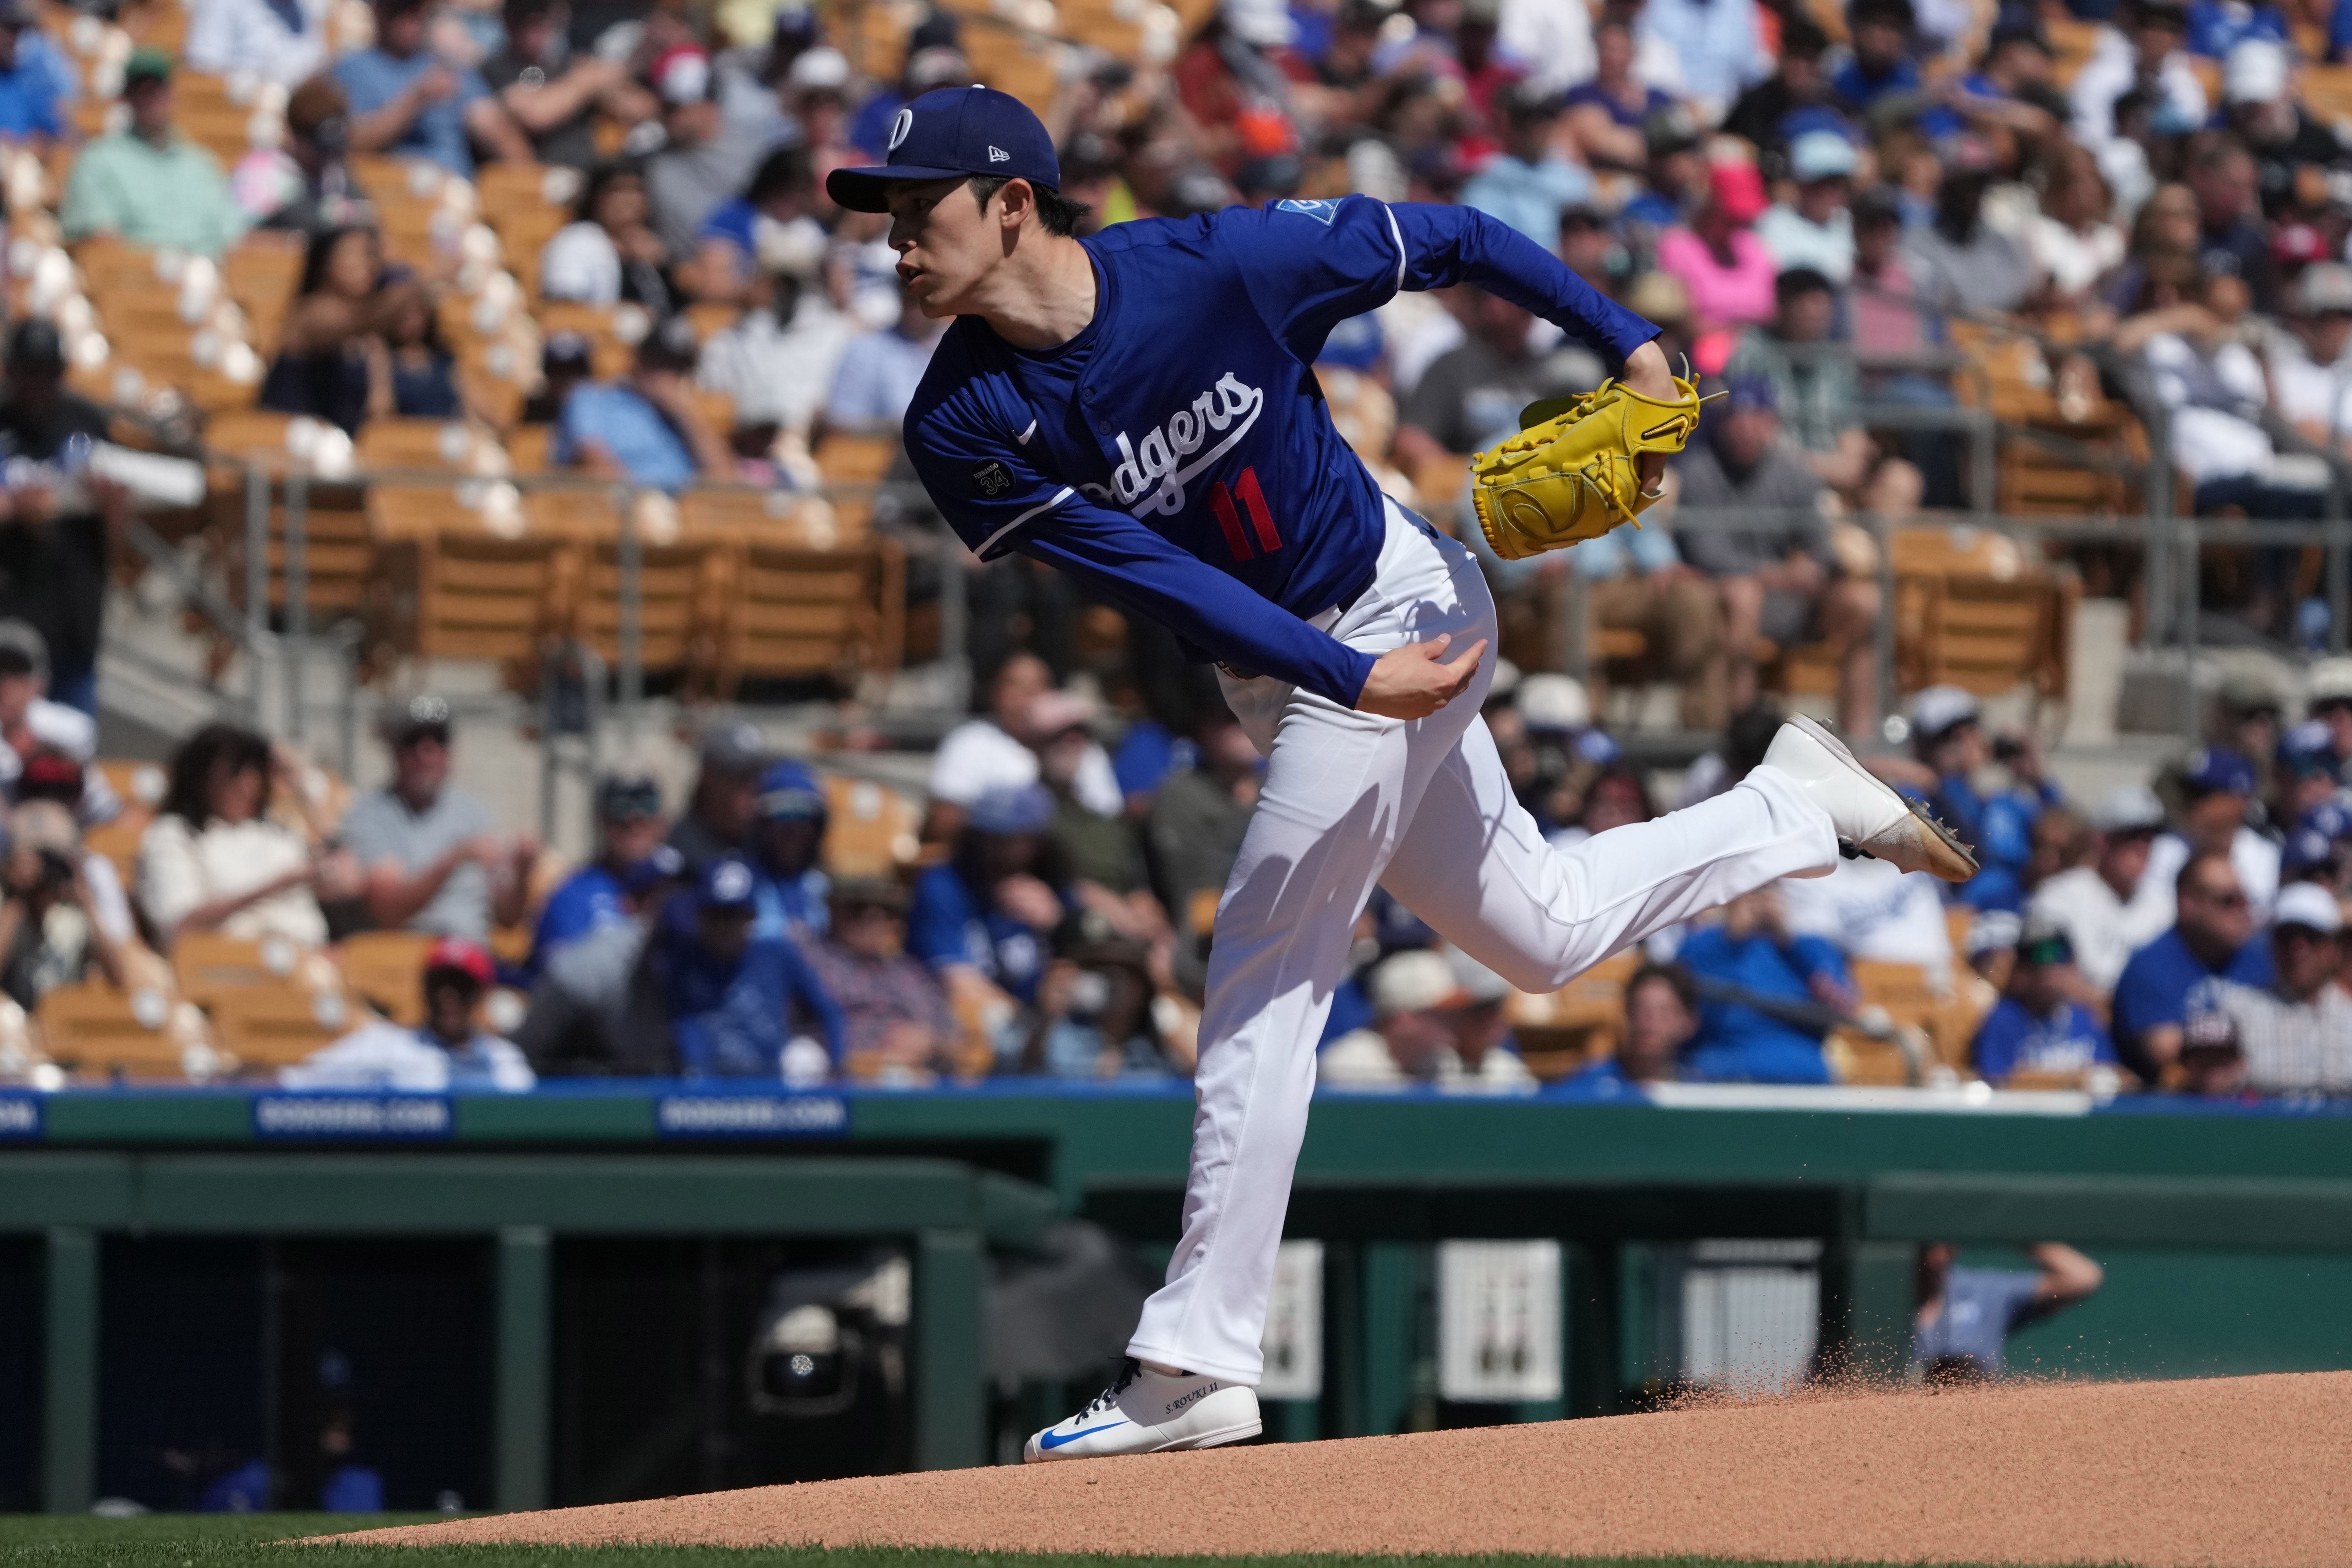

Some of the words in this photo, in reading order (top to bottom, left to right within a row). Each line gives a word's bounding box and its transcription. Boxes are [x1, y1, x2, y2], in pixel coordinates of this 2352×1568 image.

[973, 463, 998, 479] FERNANDO
[980, 469, 1010, 495] 34
[1209, 466, 1282, 562] 11
[1166, 1386, 1207, 1414] S.ROUKI
[1209, 1382, 1219, 1392] 11
